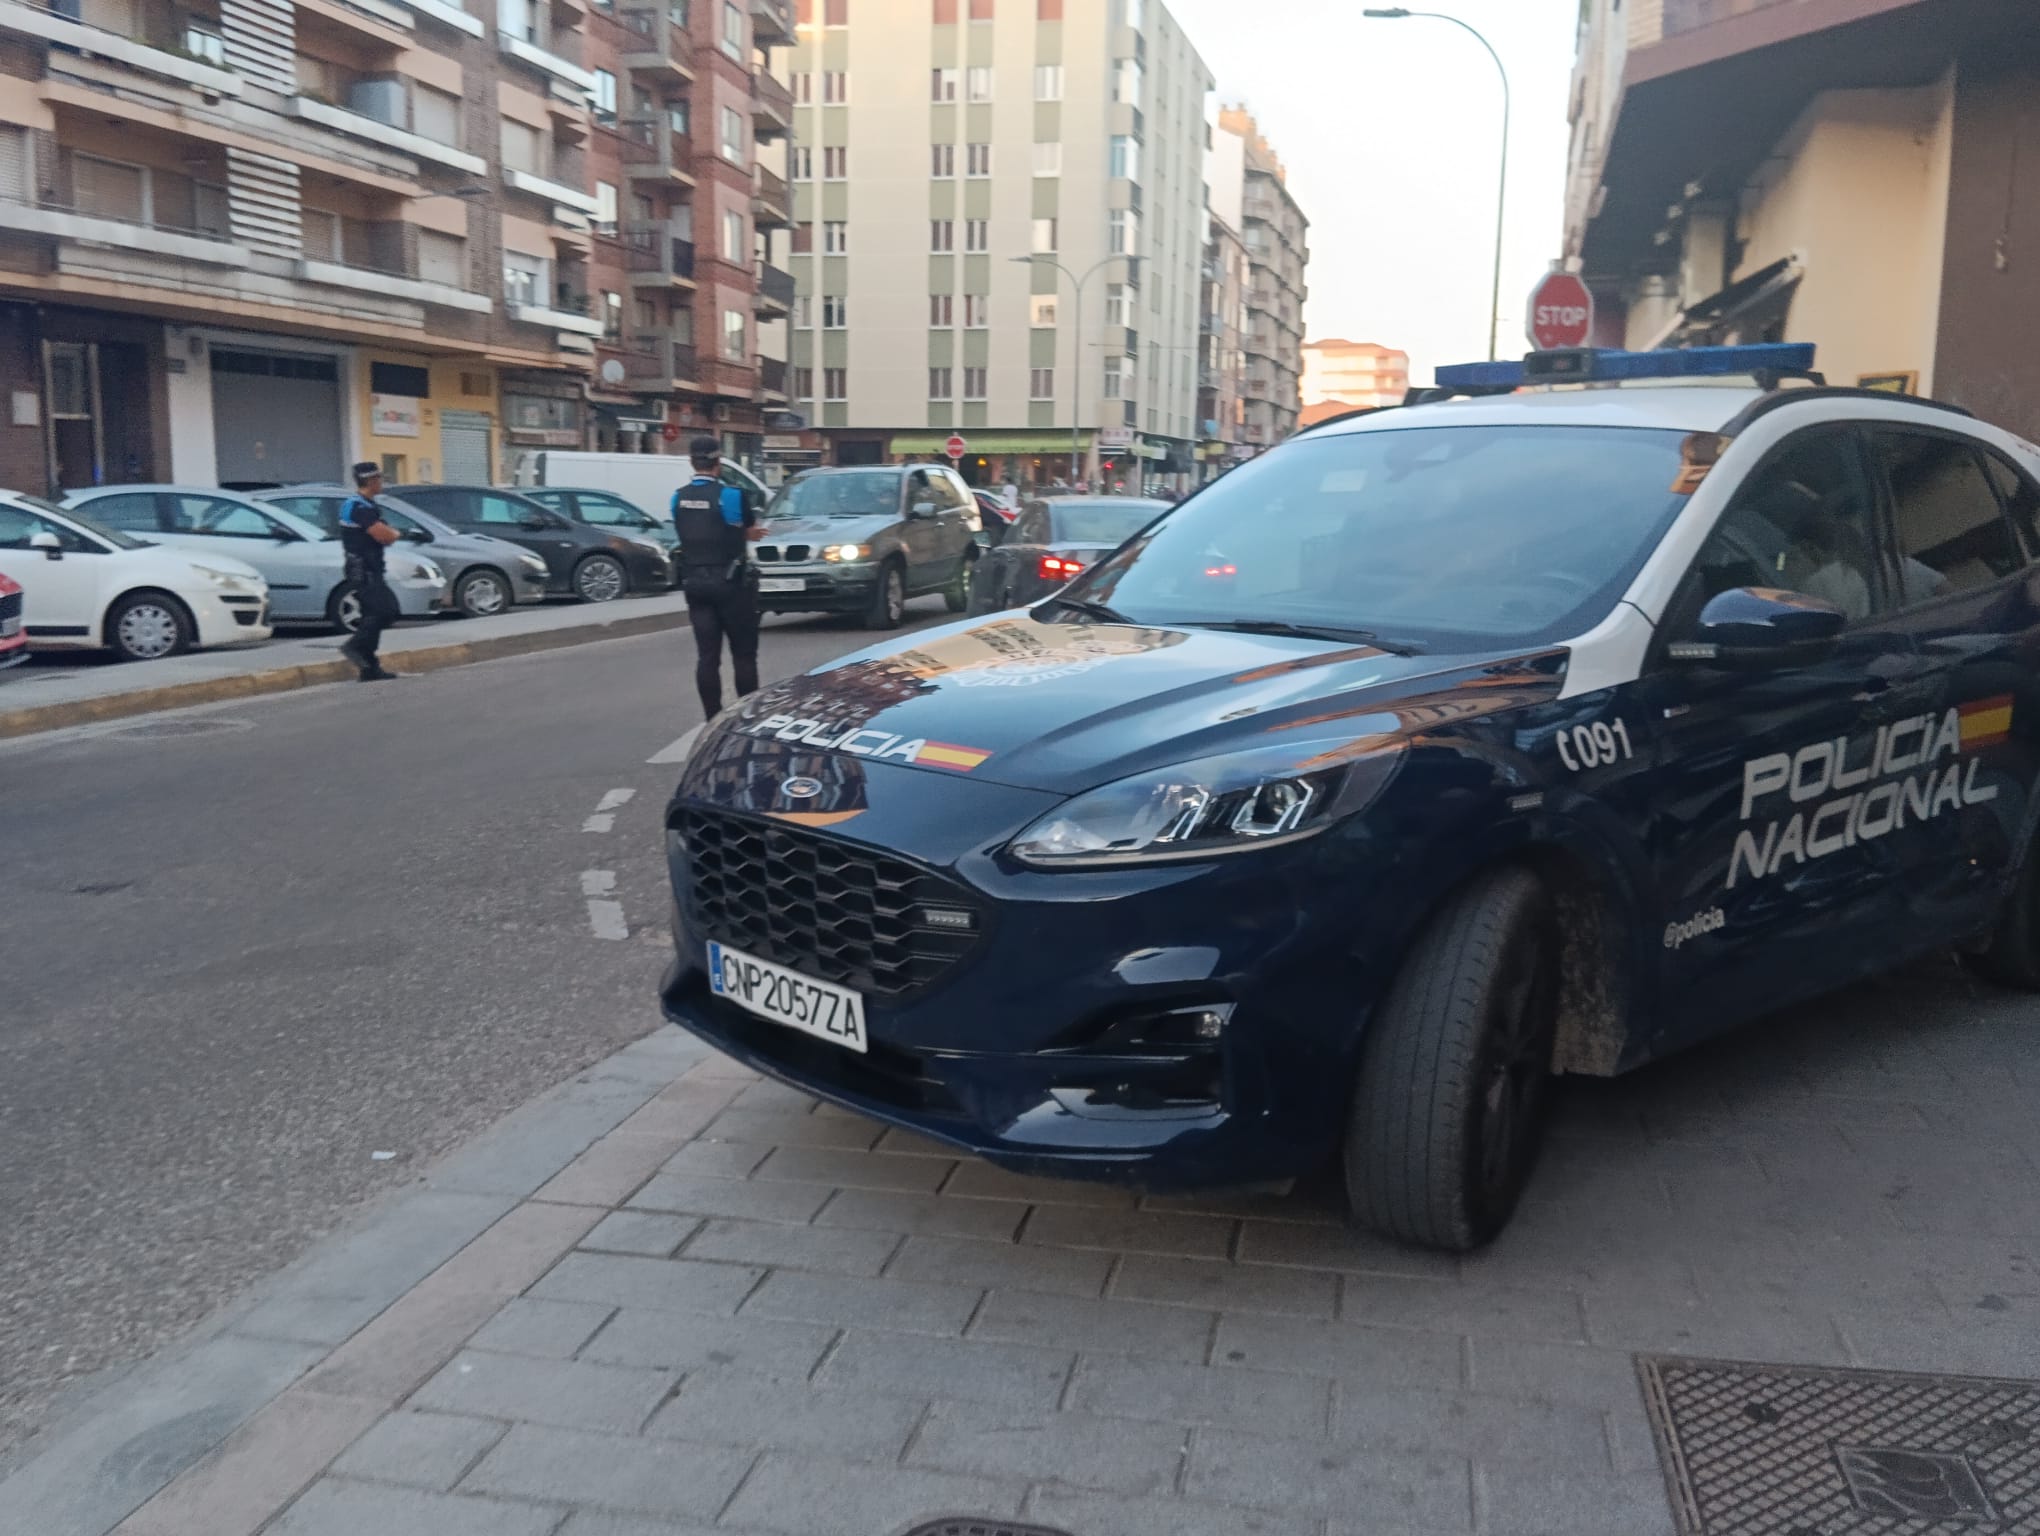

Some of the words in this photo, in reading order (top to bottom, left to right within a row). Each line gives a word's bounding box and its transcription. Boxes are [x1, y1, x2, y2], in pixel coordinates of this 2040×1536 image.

[1535, 304, 1586, 326] STOP
[1725, 757, 1999, 889] NACIONAL
[1664, 905, 1725, 949] @policia
[723, 954, 860, 1042] CNP2057ZA
